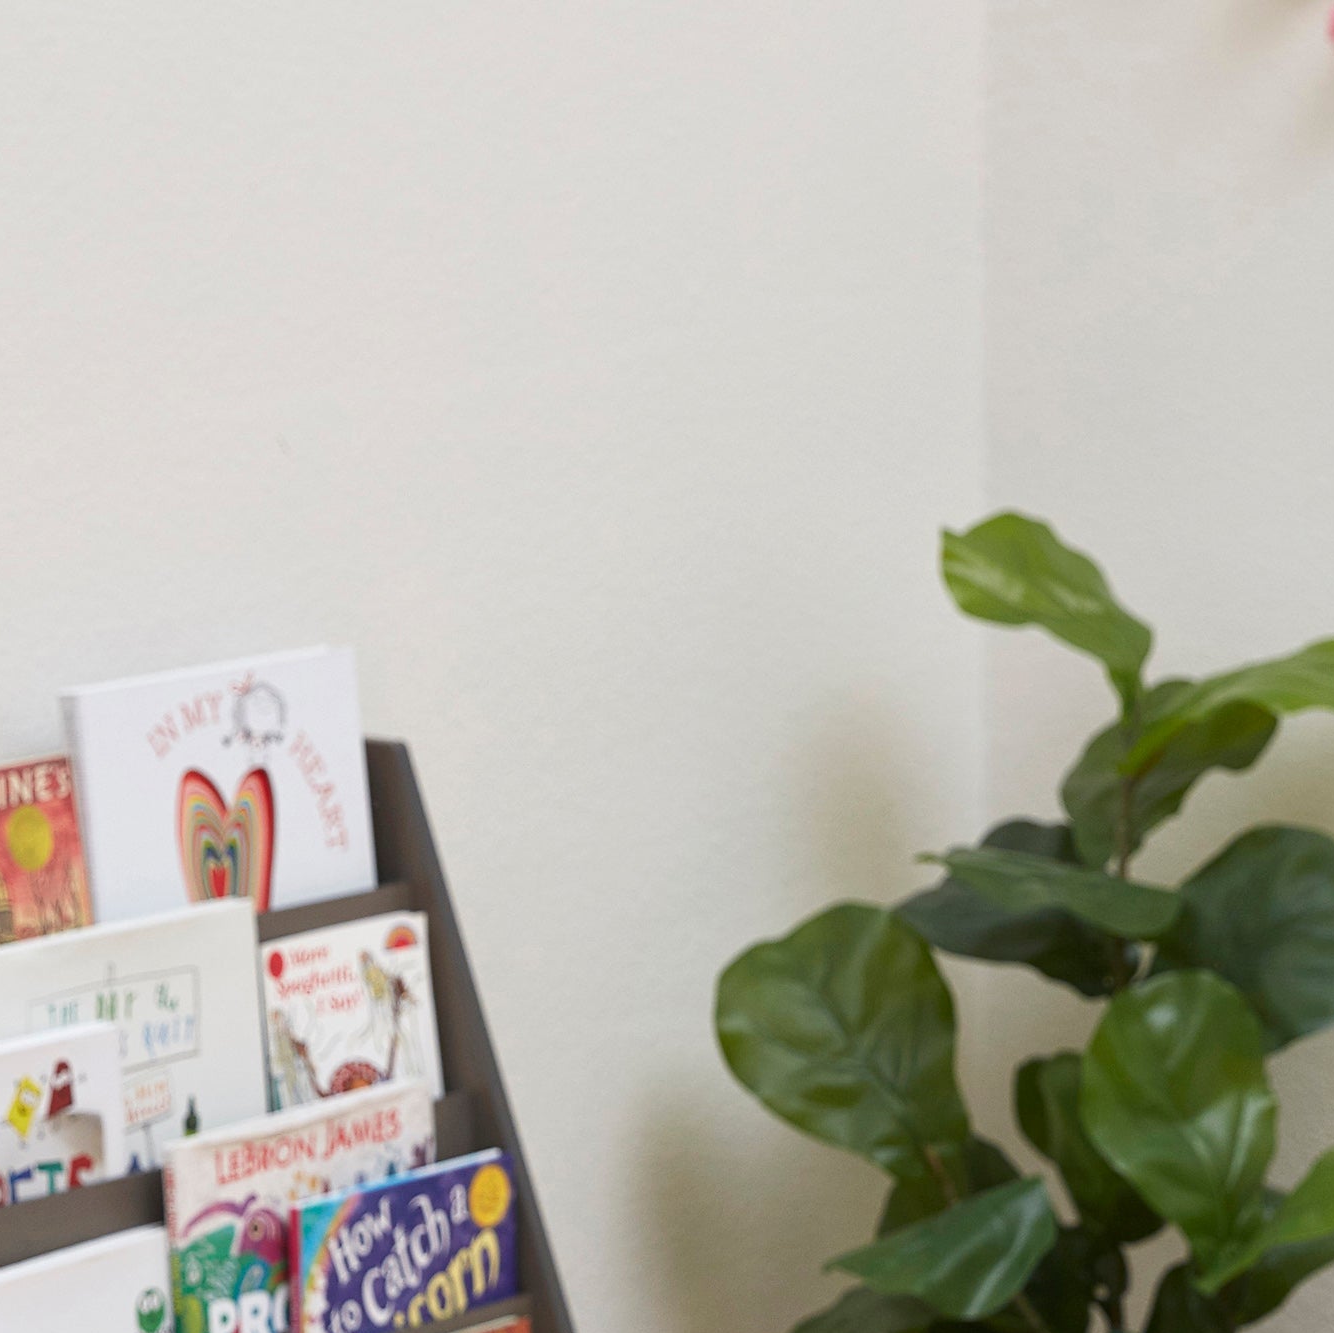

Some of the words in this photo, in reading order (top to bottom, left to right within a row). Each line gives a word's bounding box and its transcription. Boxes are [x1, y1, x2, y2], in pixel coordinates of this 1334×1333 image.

[323, 1109, 402, 1160] JAMES
[328, 1194, 392, 1286] How
[361, 1193, 451, 1327] Catch
